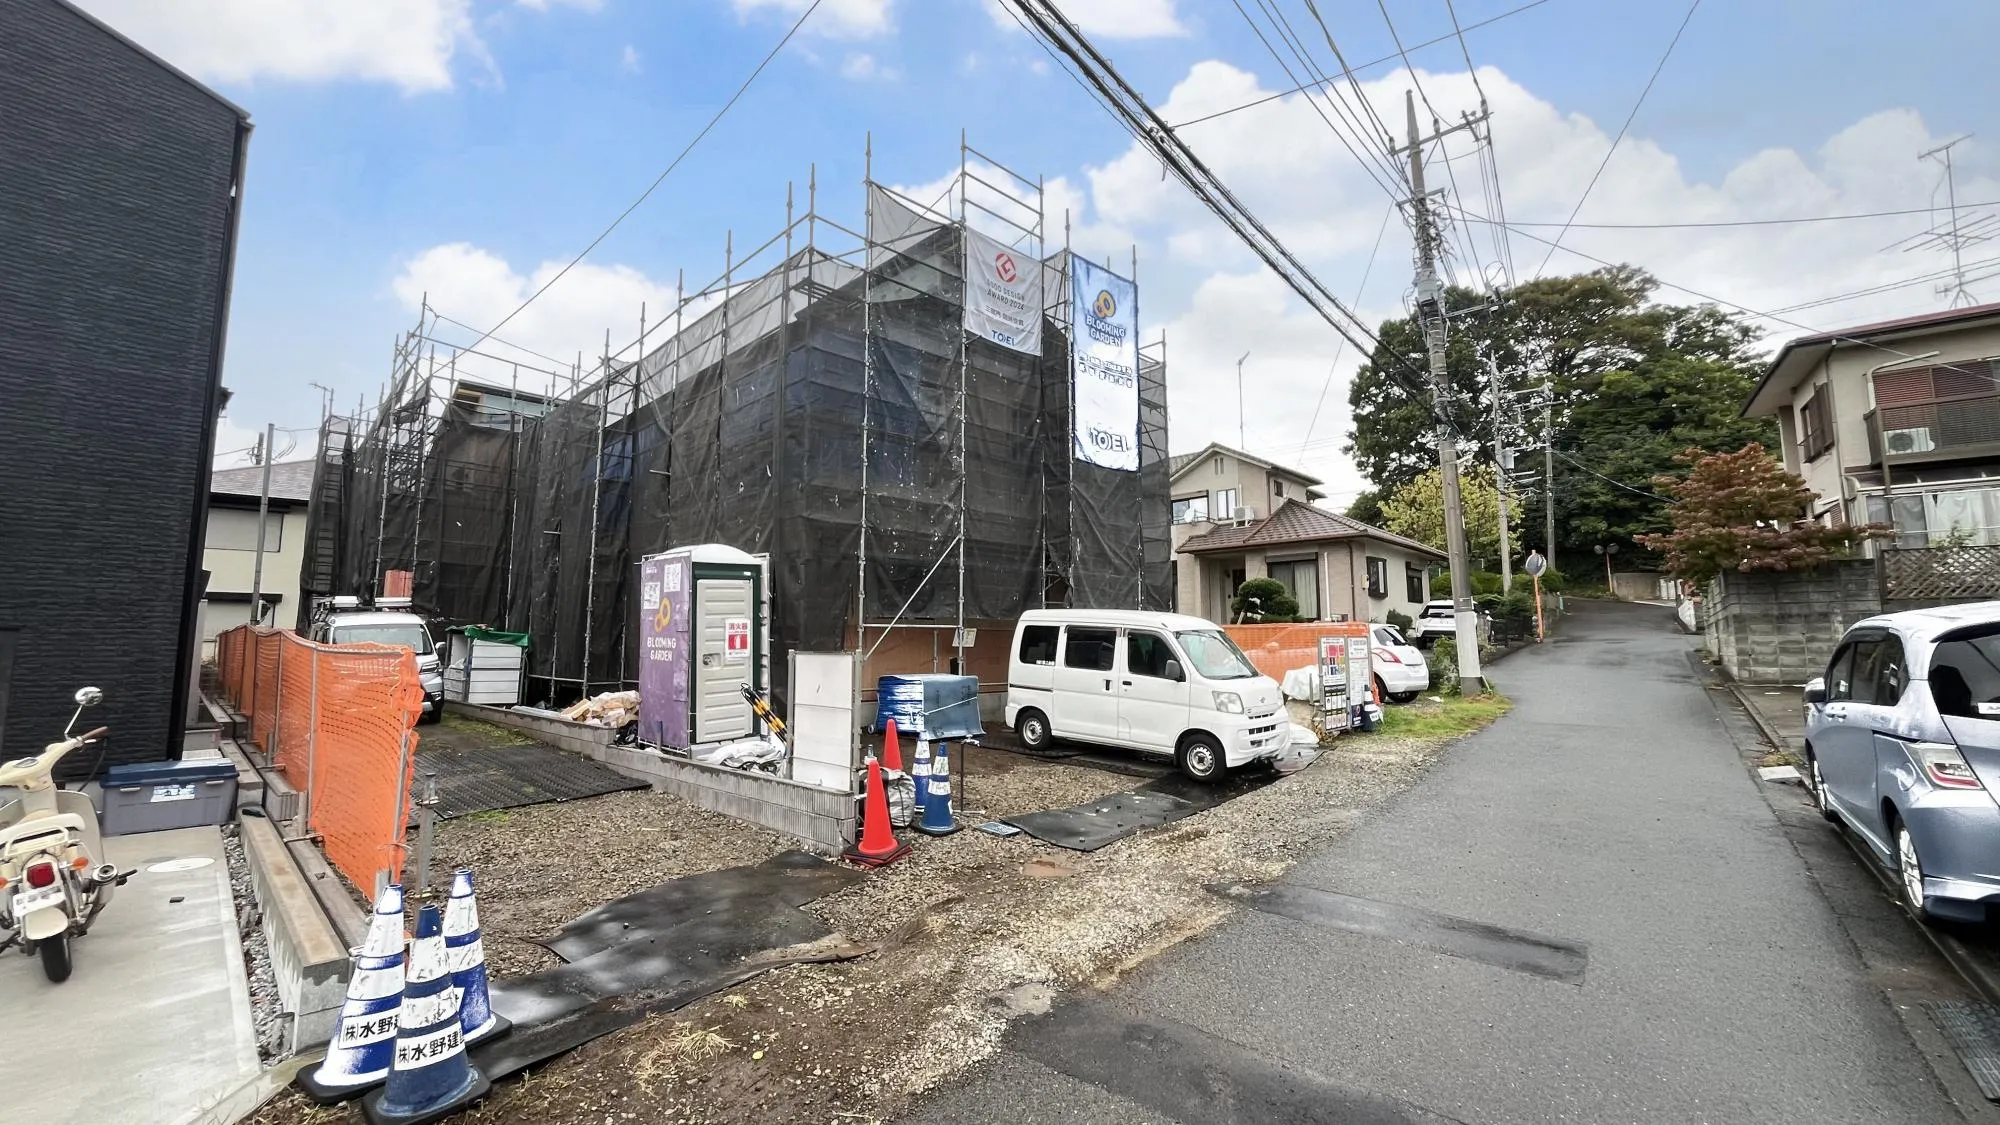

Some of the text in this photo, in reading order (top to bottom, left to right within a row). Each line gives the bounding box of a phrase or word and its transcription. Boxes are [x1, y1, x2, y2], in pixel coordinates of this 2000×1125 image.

[987, 289, 1009, 305] AWARD
[1086, 314, 1126, 337] BLOOMING
[1090, 328, 1122, 348] GARDEN
[647, 636, 677, 649] BLOOMING
[650, 649, 673, 662] GARDEN
